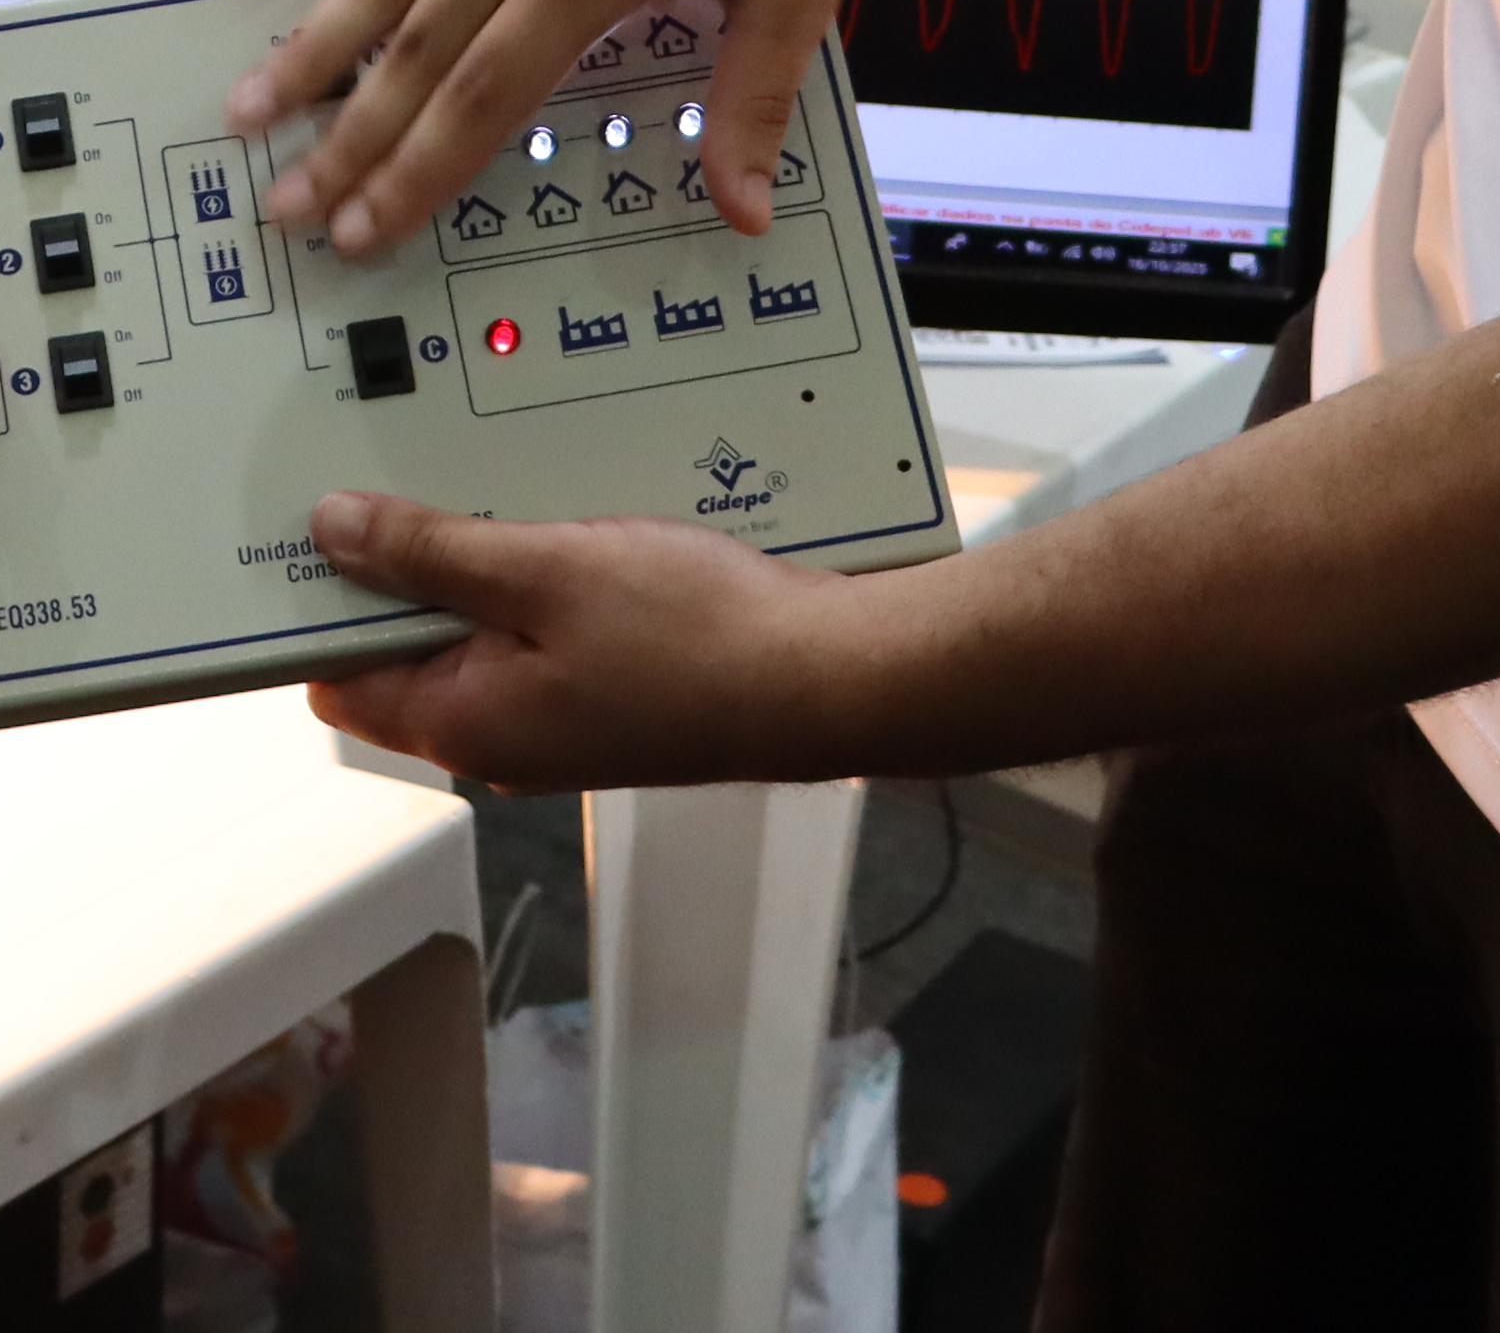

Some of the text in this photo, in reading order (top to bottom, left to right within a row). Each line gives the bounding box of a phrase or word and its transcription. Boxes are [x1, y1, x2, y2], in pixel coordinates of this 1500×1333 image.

[73, 91, 91, 104] On
[83, 149, 101, 163] Off
[95, 212, 113, 225] On
[306, 236, 326, 251] Off
[104, 270, 123, 284] Off
[114, 330, 133, 343] On
[326, 327, 345, 341] On
[124, 388, 143, 403] Off
[335, 387, 355, 402] Off
[695, 491, 773, 516] Cidepe
